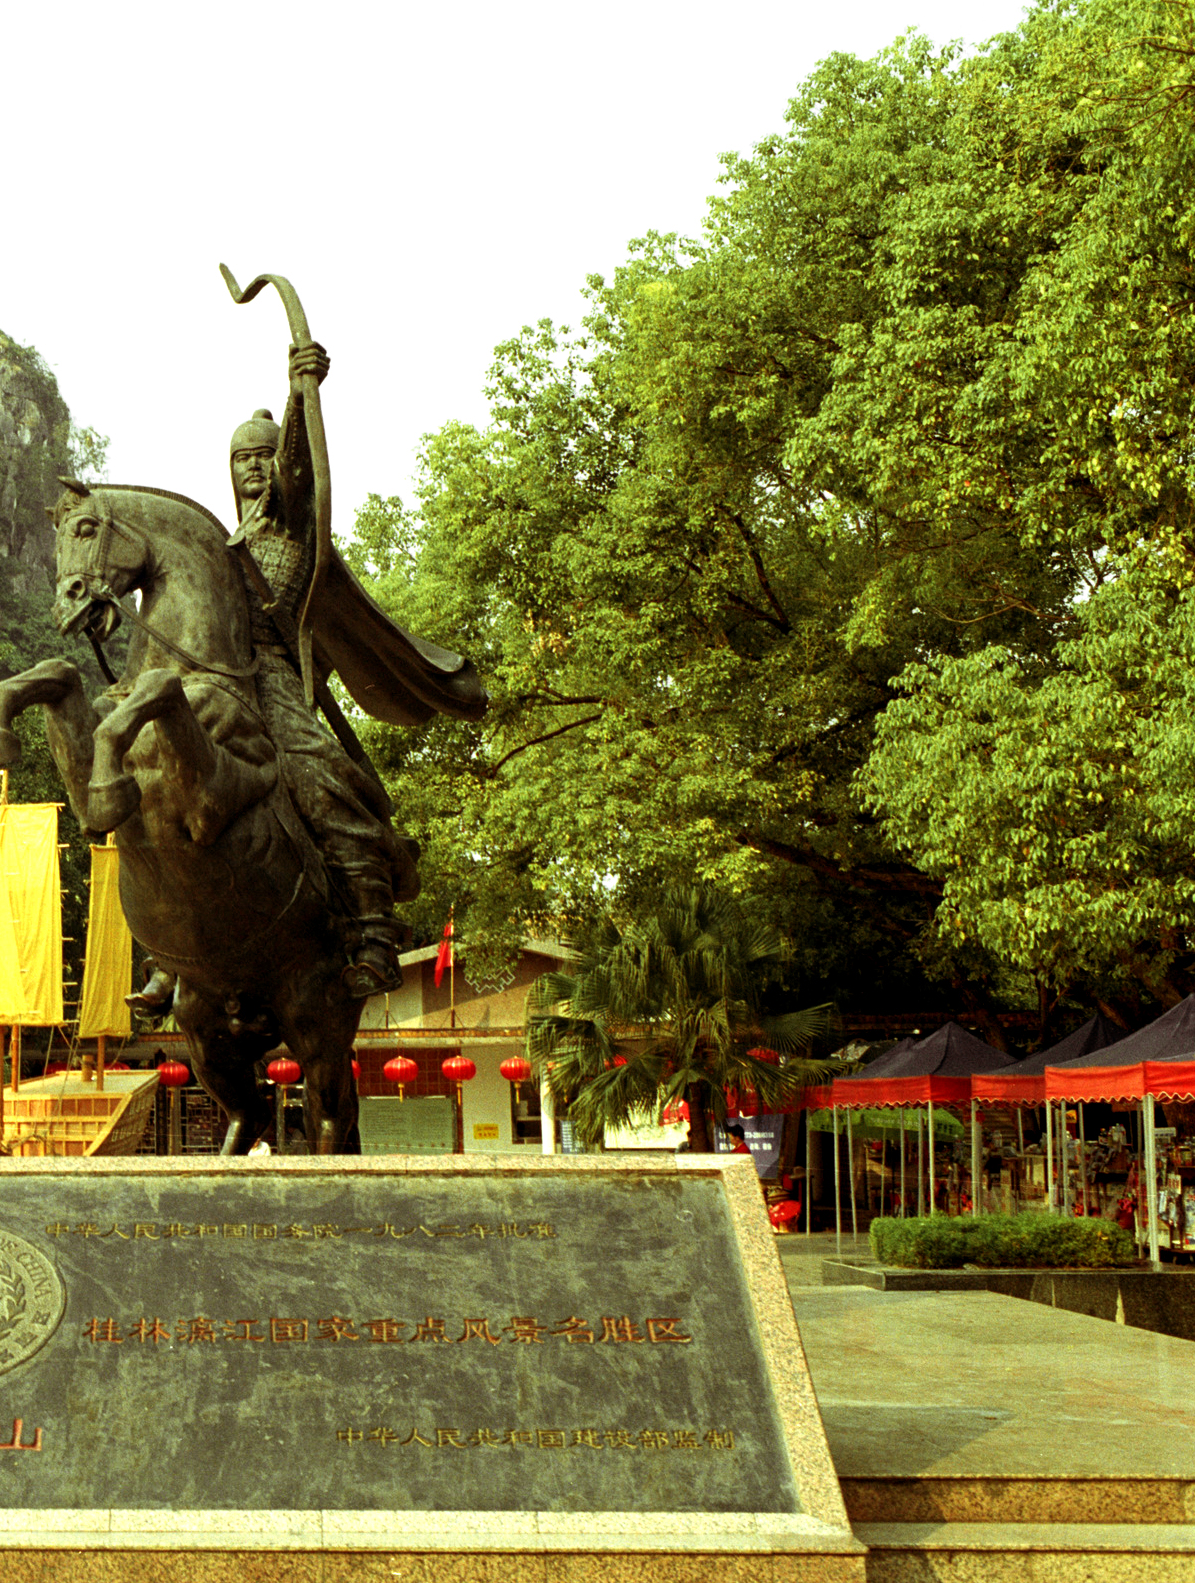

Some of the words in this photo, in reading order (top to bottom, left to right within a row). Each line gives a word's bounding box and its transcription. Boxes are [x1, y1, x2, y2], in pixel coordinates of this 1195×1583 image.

[45, 1222, 556, 1240] 中华人民共和国国务院一九八二年批准
[16, 1251, 53, 1299] CHINA
[82, 1316, 692, 1344] 桂林漓江国家重点风景名胜区
[336, 1427, 736, 1449] 中华人民共和国建设部监制
